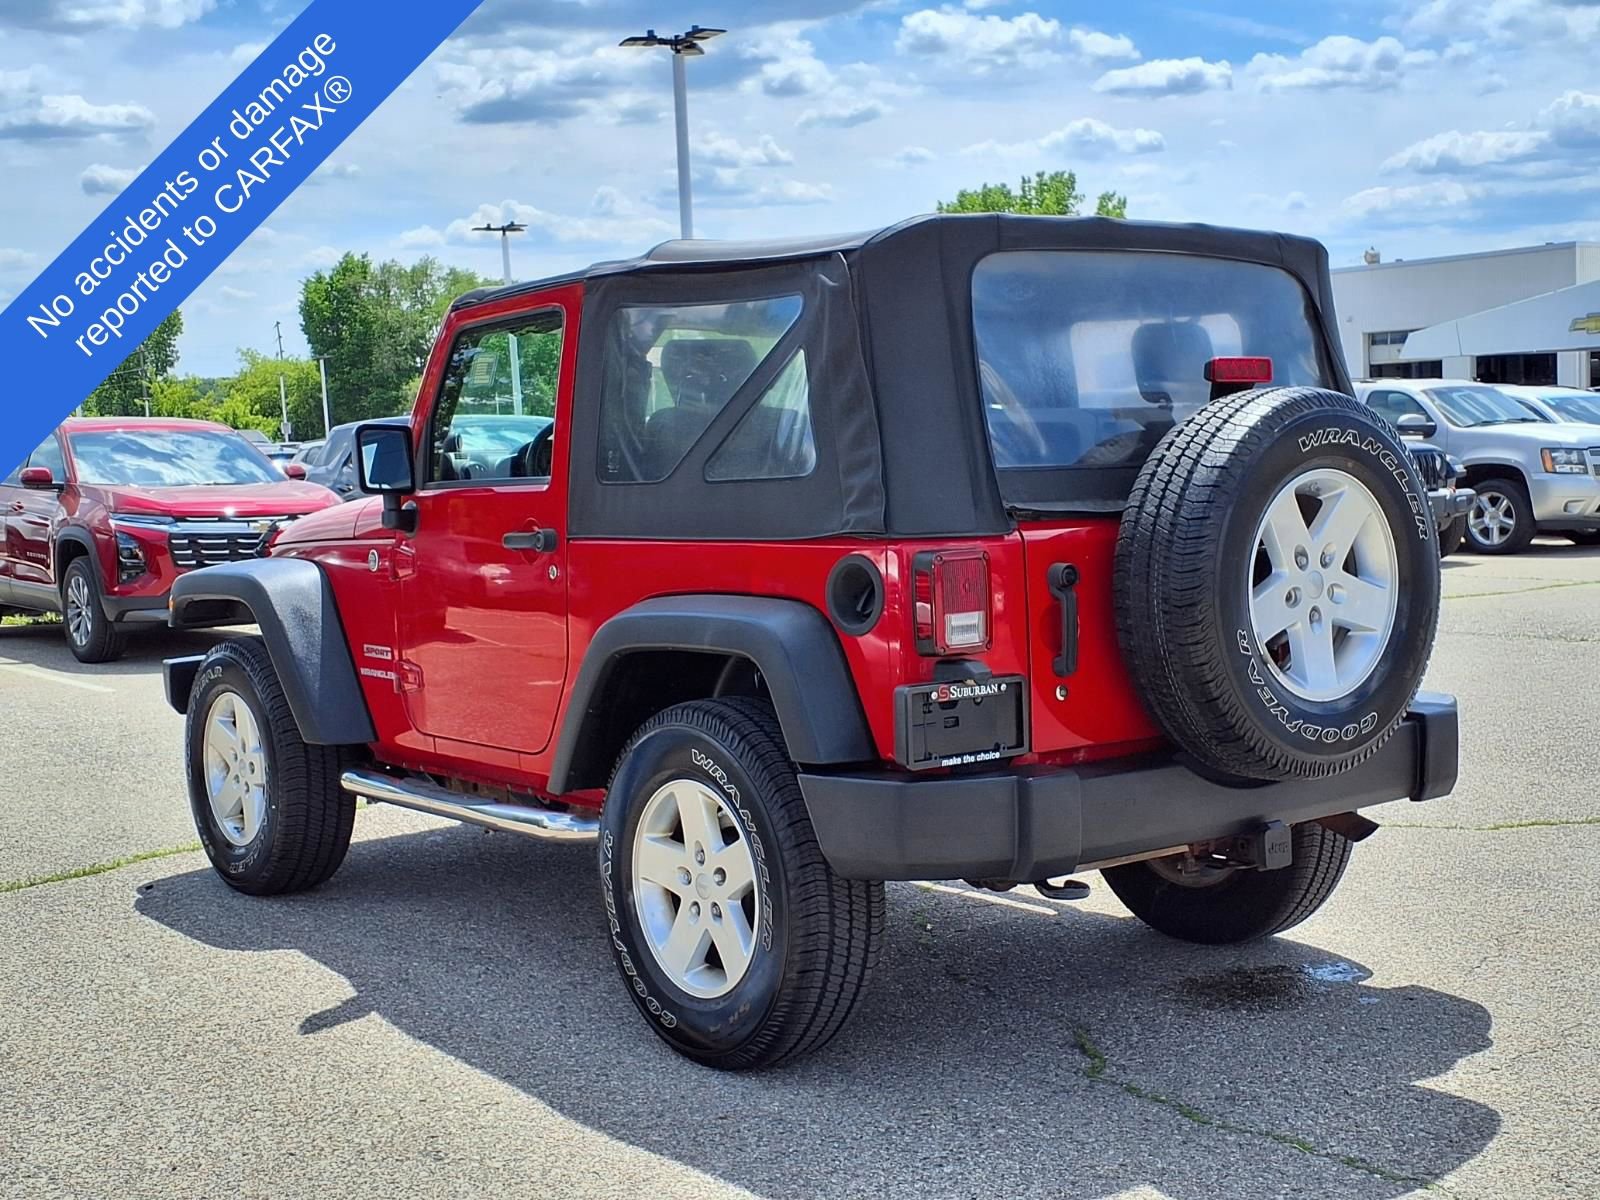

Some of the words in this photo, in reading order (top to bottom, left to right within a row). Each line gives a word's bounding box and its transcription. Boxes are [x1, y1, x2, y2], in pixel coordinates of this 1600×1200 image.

[1298, 428, 1429, 541] WRANGLER
[364, 646, 391, 658] SPORT
[1237, 629, 1378, 743] GOODYEAR
[941, 756, 961, 767] make
[963, 754, 975, 764] the
[976, 751, 1000, 762] choice
[691, 749, 774, 952] WRANGLER
[602, 830, 677, 1028] GOODYEAR
